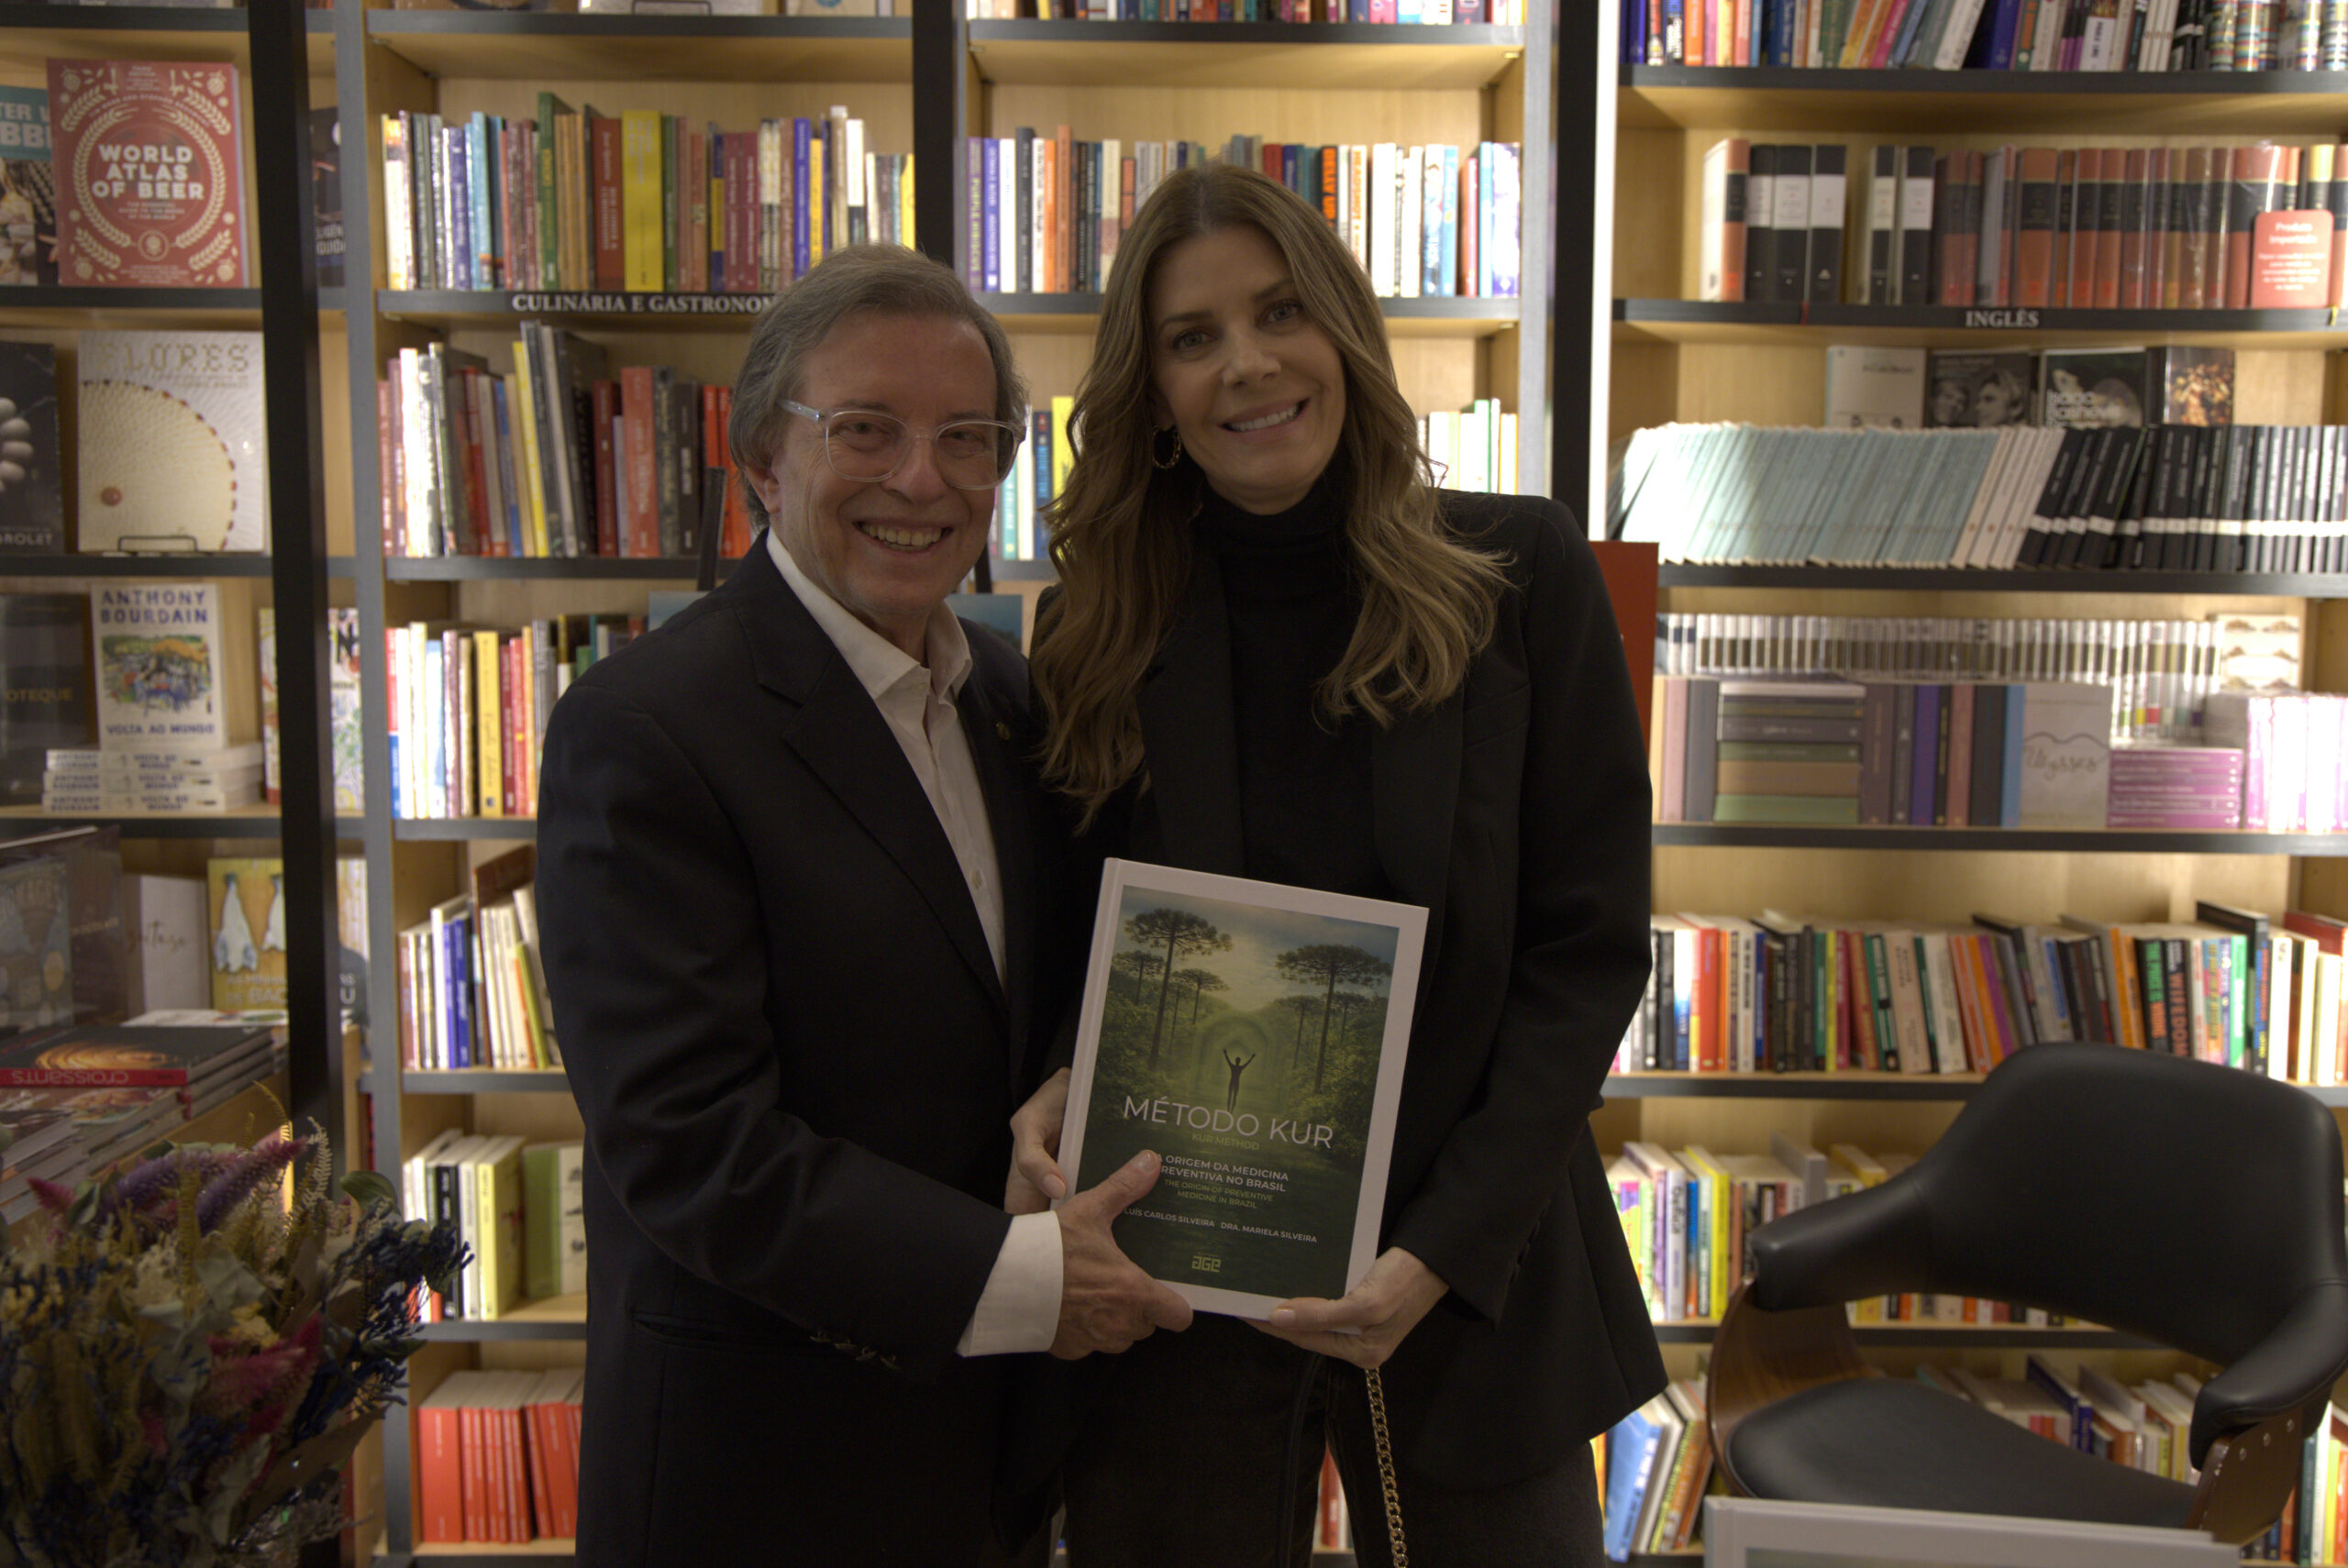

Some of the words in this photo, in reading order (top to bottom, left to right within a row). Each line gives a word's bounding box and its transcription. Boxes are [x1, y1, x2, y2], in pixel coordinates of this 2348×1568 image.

[98, 145, 193, 163] WORLD
[106, 163, 188, 181] ATLAS
[1322, 148, 1337, 193] BELLY
[93, 181, 125, 198] OF
[138, 182, 204, 200] BEER
[512, 290, 626, 312] CULINÁRIA
[631, 295, 645, 312] E
[1966, 308, 2039, 327] INGLÊS
[96, 341, 249, 372] FLORES
[101, 591, 205, 606] ANTHONY
[101, 608, 208, 624] BOURDAIN
[107, 724, 142, 734] VOLTA
[150, 724, 165, 733] AO
[171, 724, 214, 734] MUNDO
[1124, 1095, 1259, 1137] MÉTODO
[1269, 1117, 1334, 1148] KUR
[1192, 1132, 1213, 1144] KUR
[1214, 1135, 1259, 1150] METHOD
[1166, 1154, 1211, 1170] ORIGEM
[1213, 1162, 1230, 1172] DA
[1233, 1165, 1289, 1182] MEDICINA
[1164, 1178, 1180, 1189] THE
[1181, 1181, 1211, 1193] ORIGIN
[1212, 1184, 1224, 1194] OF
[1224, 1187, 1273, 1202] PREVENTIVE
[1226, 1175, 1243, 1186] NO
[1246, 1177, 1287, 1192] BRASIL
[1178, 1191, 1217, 1203] MEDICINE
[1219, 1196, 1227, 1204] IN
[1229, 1197, 1257, 1209] BRAZIL
[1124, 1207, 1143, 1217] LUÍS
[1144, 1210, 1177, 1223] CARLOS
[1178, 1215, 1215, 1228] SILVEIRA
[1221, 1221, 1240, 1232] DRA.
[1242, 1225, 1279, 1238] MARIELA
[1280, 1231, 1317, 1243] SILVEIRA
